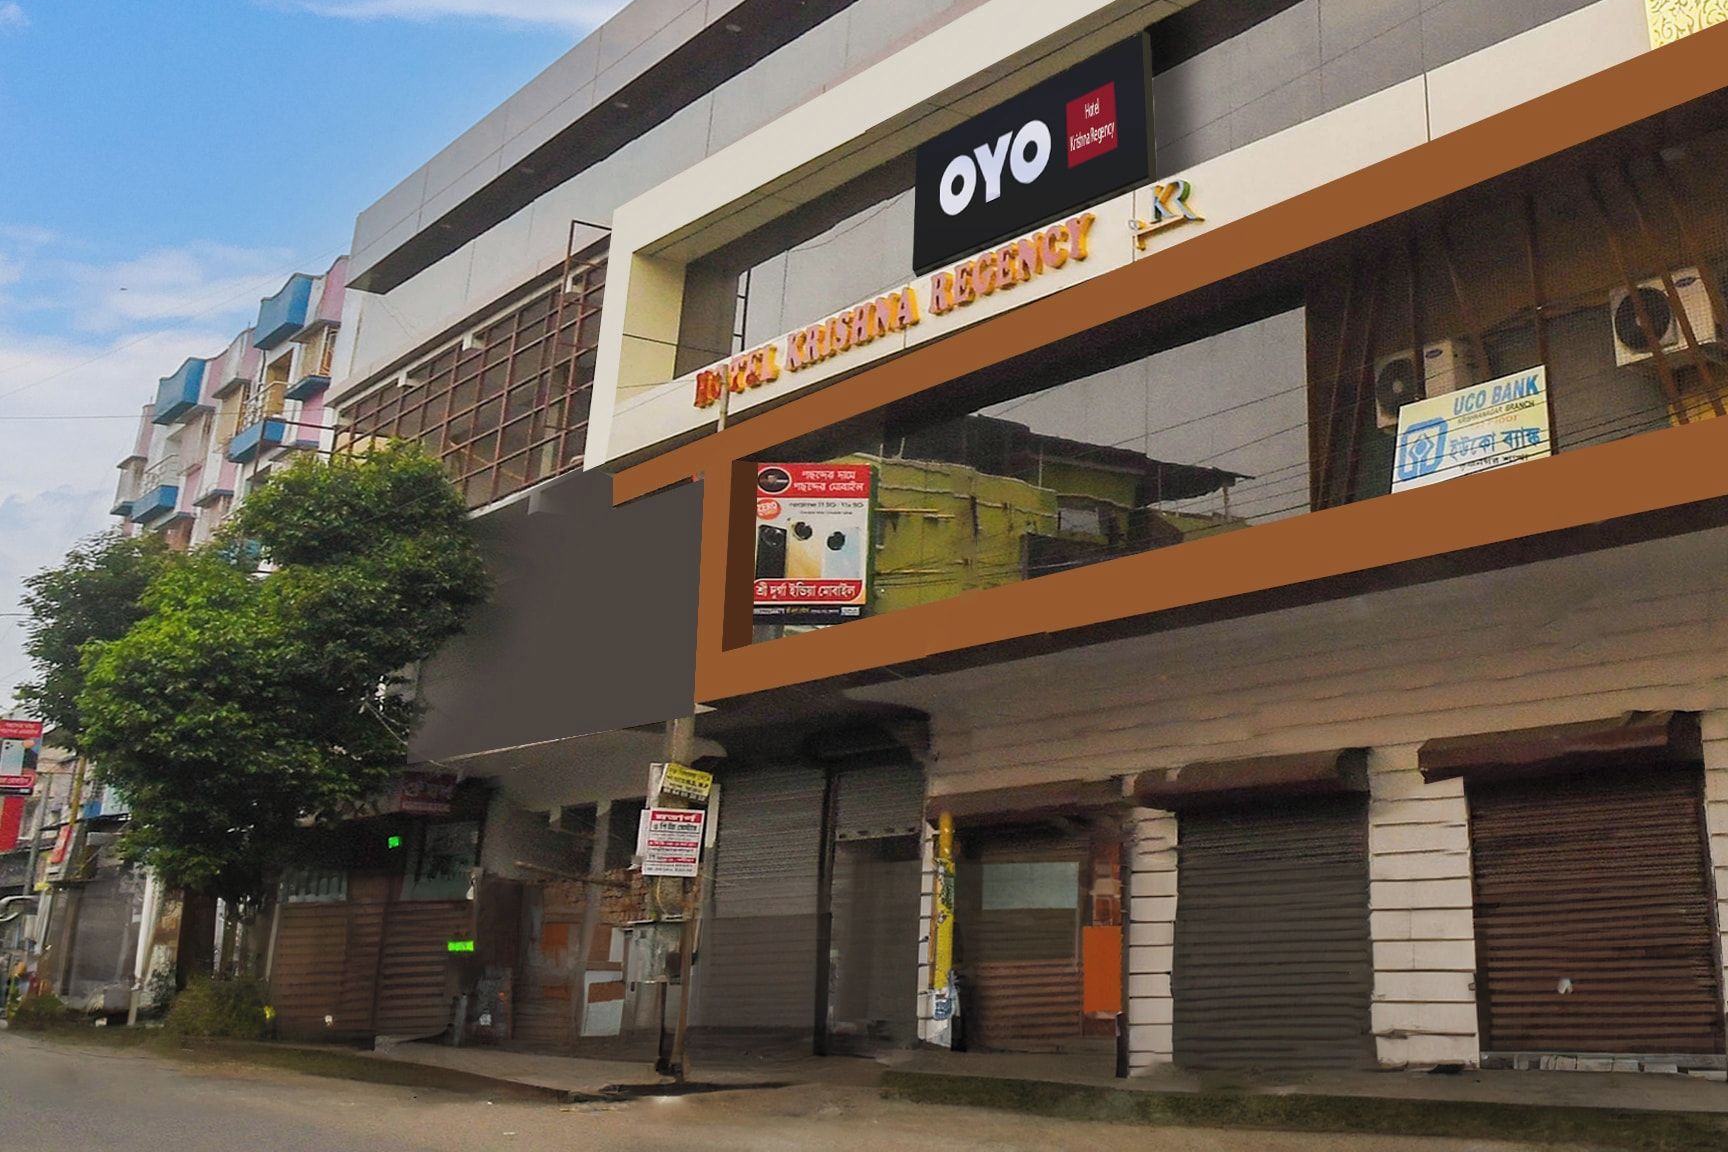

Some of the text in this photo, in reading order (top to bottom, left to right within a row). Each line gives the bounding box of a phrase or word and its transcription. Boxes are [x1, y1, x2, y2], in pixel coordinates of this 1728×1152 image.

[1084, 97, 1100, 119] Hotel
[1090, 121, 1115, 144] Regency
[939, 119, 1051, 216] OYO
[785, 286, 920, 371] KRISHNA
[929, 212, 1096, 316] REGENCY
[1453, 375, 1539, 416] UCO BANK
